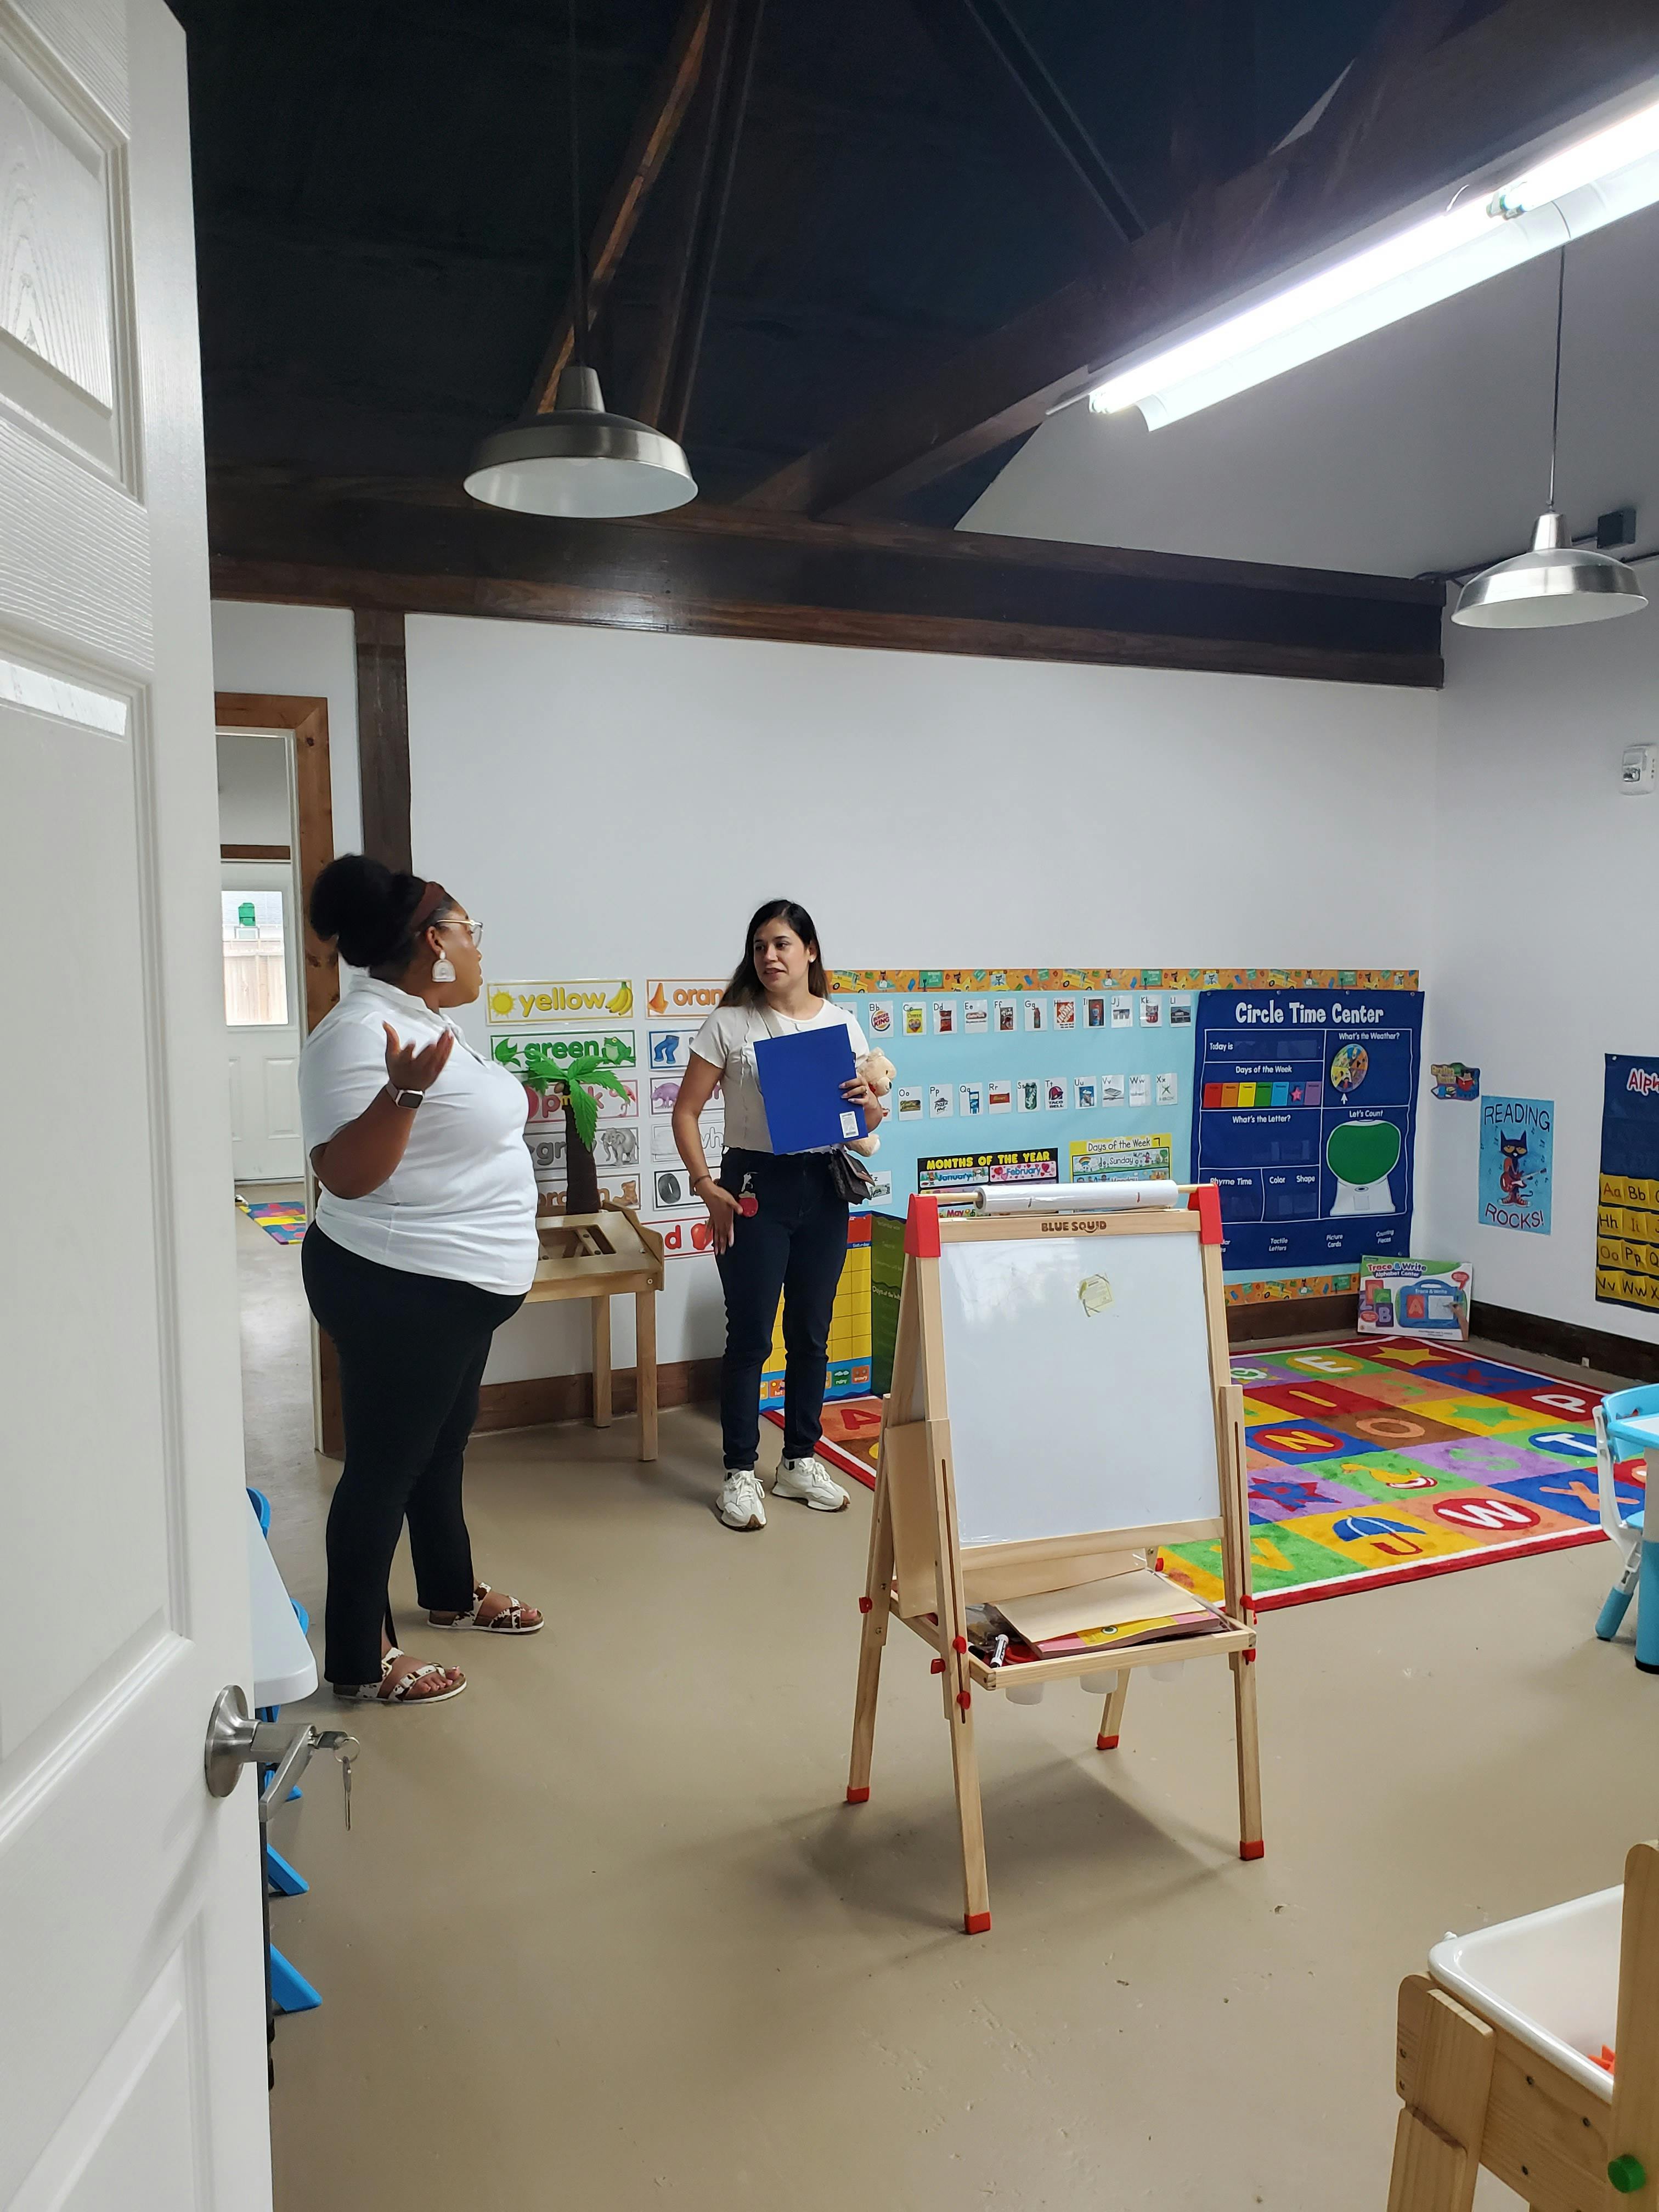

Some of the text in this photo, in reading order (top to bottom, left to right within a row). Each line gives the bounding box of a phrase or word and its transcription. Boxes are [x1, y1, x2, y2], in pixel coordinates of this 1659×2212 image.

[519, 987, 606, 1017] yellow
[673, 989, 724, 1006] oran
[1111, 998, 1120, 1007] Jj
[964, 1002, 973, 1010] Ee
[1025, 1001, 1035, 1010] Gg
[1236, 1000, 1384, 1023] Circle Time Center
[874, 1017, 890, 1028] KING
[524, 1041, 599, 1064] green
[1210, 1042, 1227, 1051] Today
[1235, 1066, 1252, 1075] Days
[930, 1087, 940, 1097] Pp
[1485, 1104, 1550, 1132] READING
[1088, 1143, 1106, 1152] Days
[1108, 1141, 1117, 1150] of
[1119, 1139, 1131, 1149] the
[1132, 1137, 1150, 1147] Week
[927, 1151, 1050, 1170] MONTHS OF THE YEAR
[1110, 1156, 1133, 1166] Sunday
[938, 1173, 971, 1182] January
[1006, 1167, 1041, 1176] February
[1296, 1175, 1315, 1183] Shape
[1604, 1182, 1621, 1197] Aa
[1628, 1186, 1645, 1200] Bb
[1486, 1203, 1544, 1229] ROCKS!
[1599, 1214, 1618, 1228] Hh
[1041, 1221, 1107, 1233] BLUE SQUID
[1632, 1218, 1640, 1232] Ii
[1600, 1246, 1619, 1261] Oo
[1626, 1246, 1641, 1267] Pp
[1402, 1263, 1427, 1272] Write
[1596, 1276, 1616, 1291] Vv
[1622, 1278, 1647, 1296] Ww
